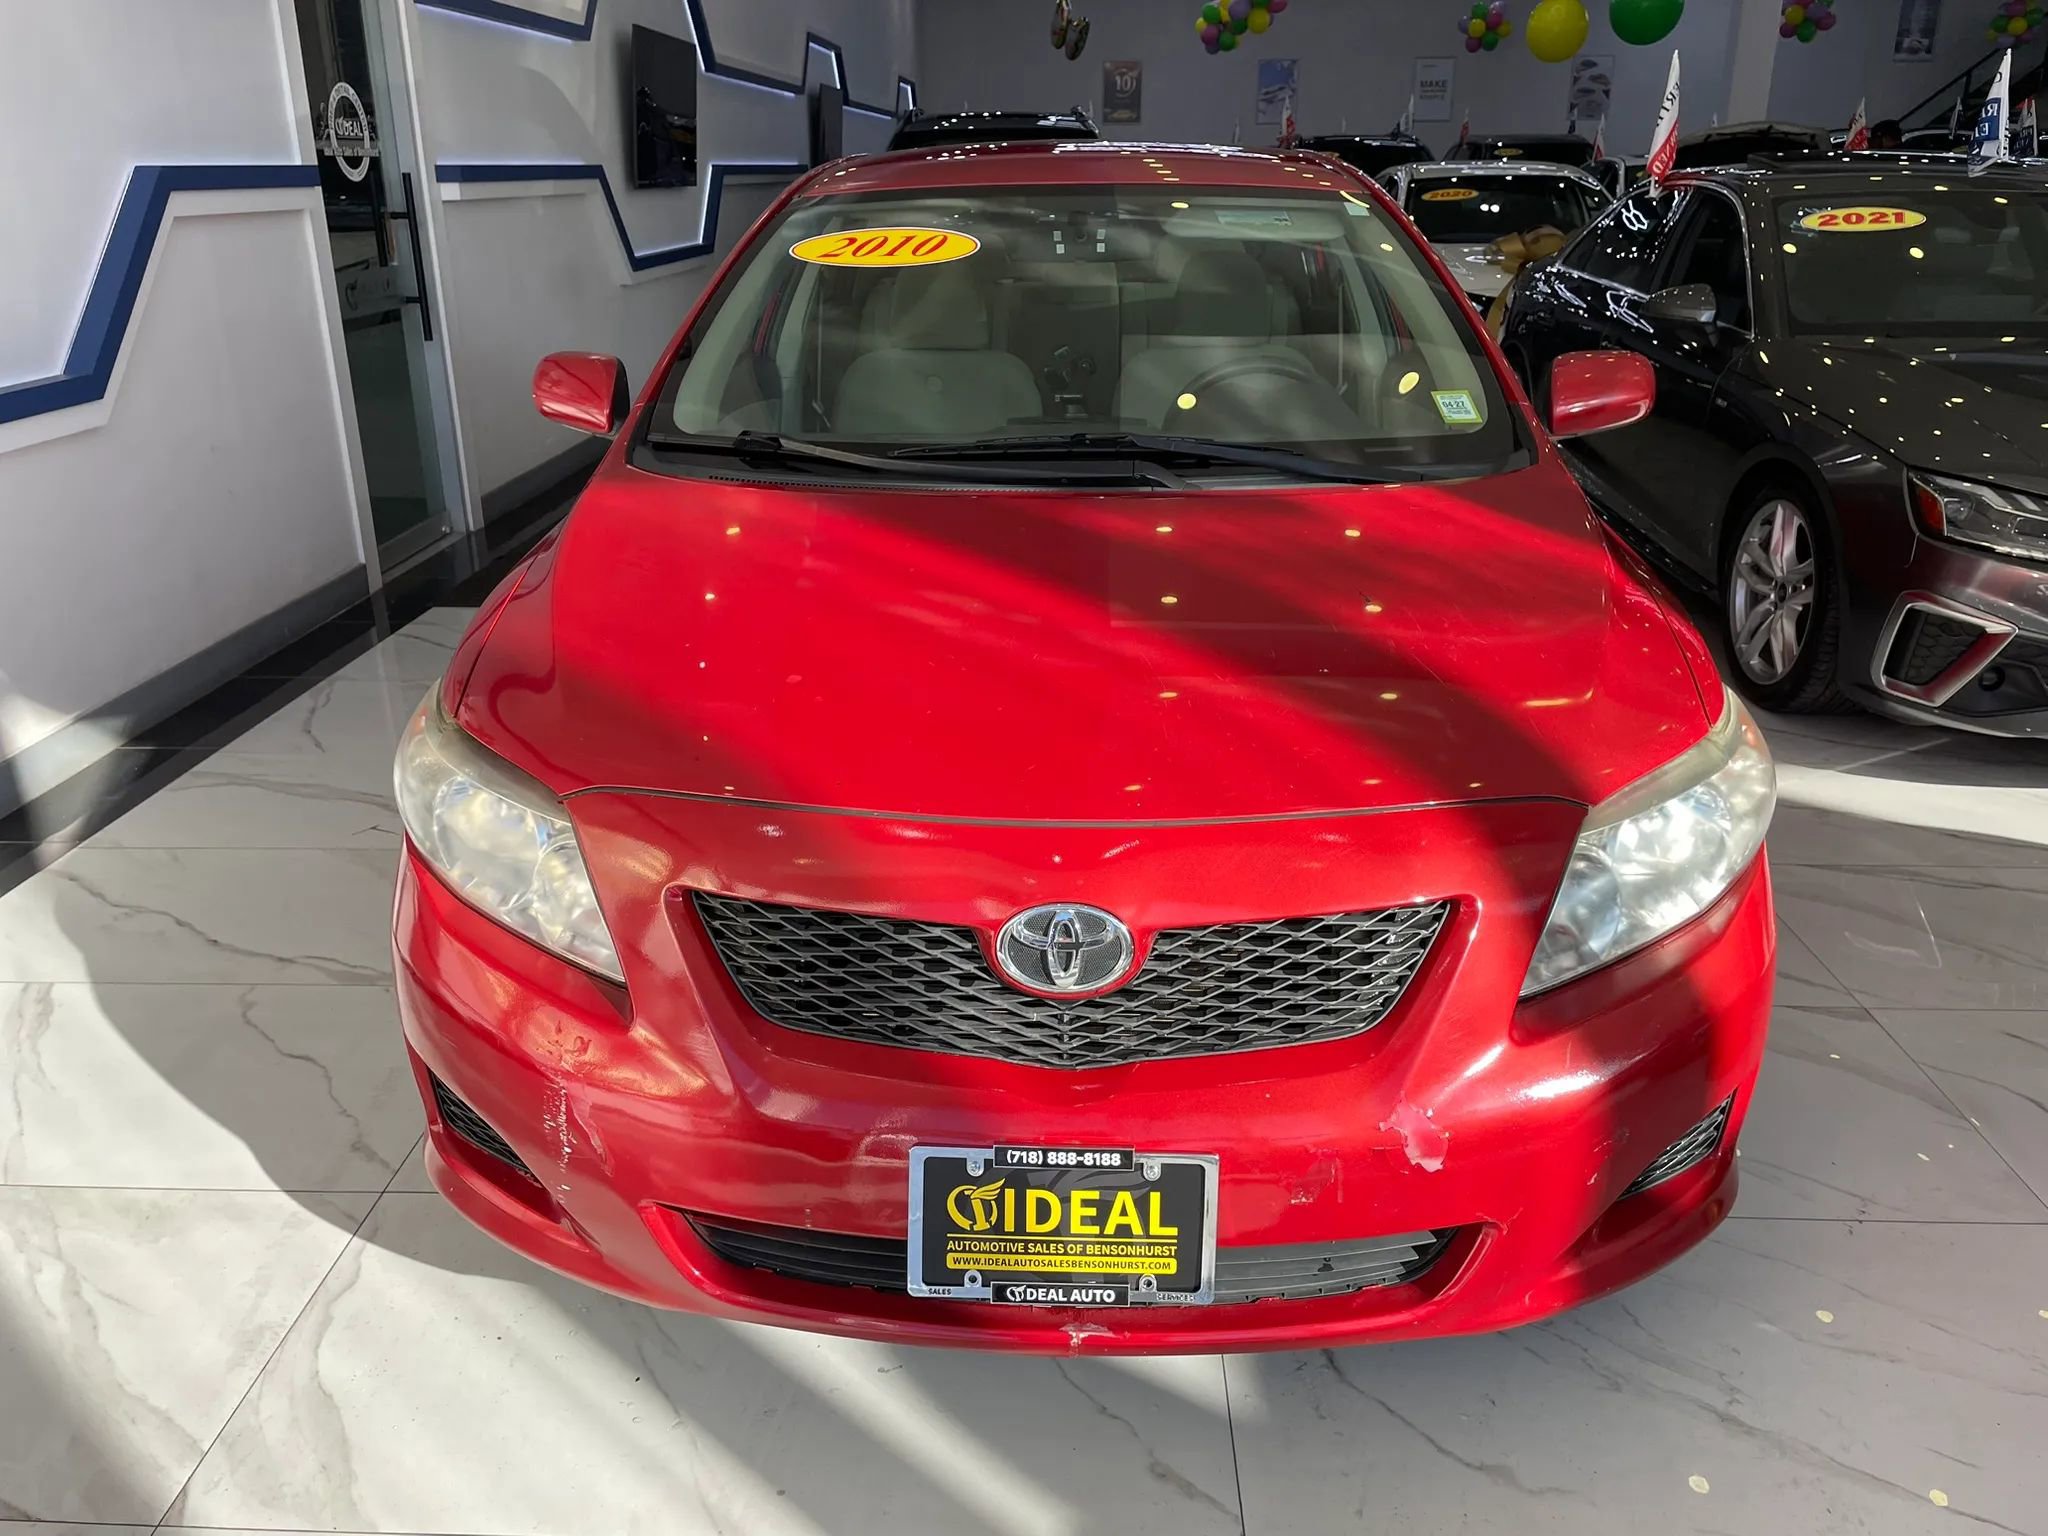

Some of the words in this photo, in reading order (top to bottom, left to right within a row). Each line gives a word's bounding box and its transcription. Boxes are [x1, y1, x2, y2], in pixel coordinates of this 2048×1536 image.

[1817, 211, 1906, 227] 2021
[817, 234, 948, 258] 2010
[1007, 1150, 1043, 1165] (718)
[1047, 1151, 1121, 1166] 888-8188
[947, 1240, 1026, 1253] AUTOMOTIVE
[1028, 1242, 1065, 1254] SALES
[1068, 1244, 1083, 1255] OF
[1086, 1244, 1177, 1257] BENSONHURST
[952, 1256, 1171, 1271] WWW.IDEALAUTOSALESBENSONHURST.COM
[928, 1287, 951, 1296] SALES
[1070, 1288, 1115, 1303] AUTO
